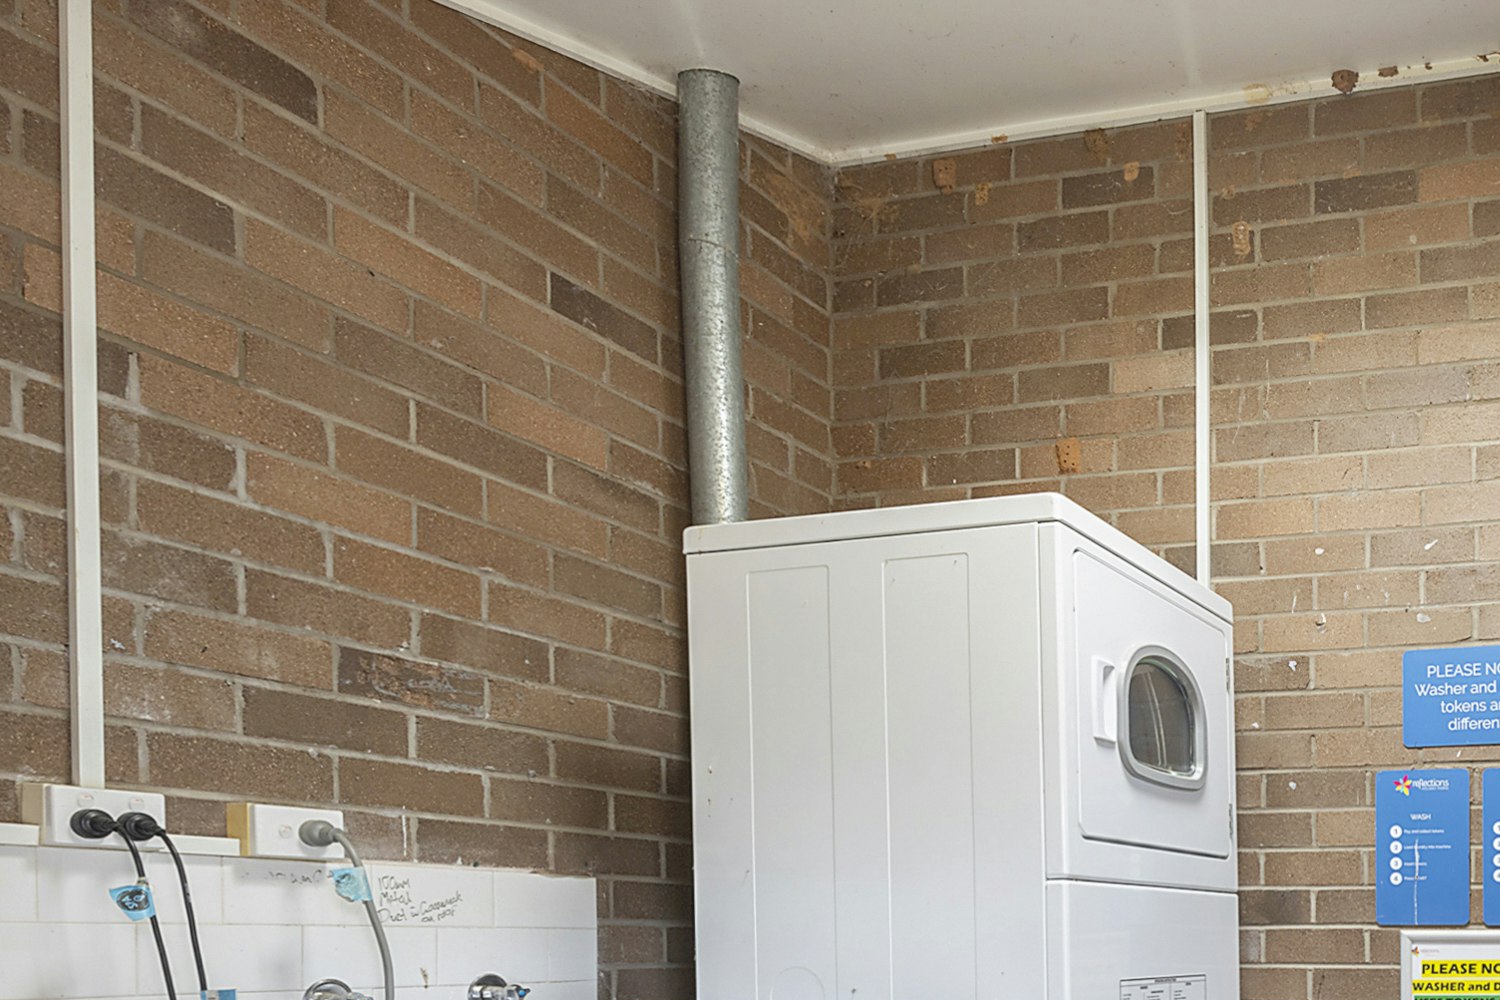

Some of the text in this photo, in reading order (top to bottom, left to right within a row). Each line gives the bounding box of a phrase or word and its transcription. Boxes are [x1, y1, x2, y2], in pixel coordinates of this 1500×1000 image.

[1427, 662, 1482, 678] PLEASE
[1415, 683, 1466, 697] Washer
[1470, 681, 1496, 694] and
[1440, 700, 1486, 714] tokens
[1412, 778, 1449, 789] reflections
[1422, 963, 1477, 974] PLEASE
[1412, 982, 1465, 991] WASHER
[1468, 982, 1490, 991] and
